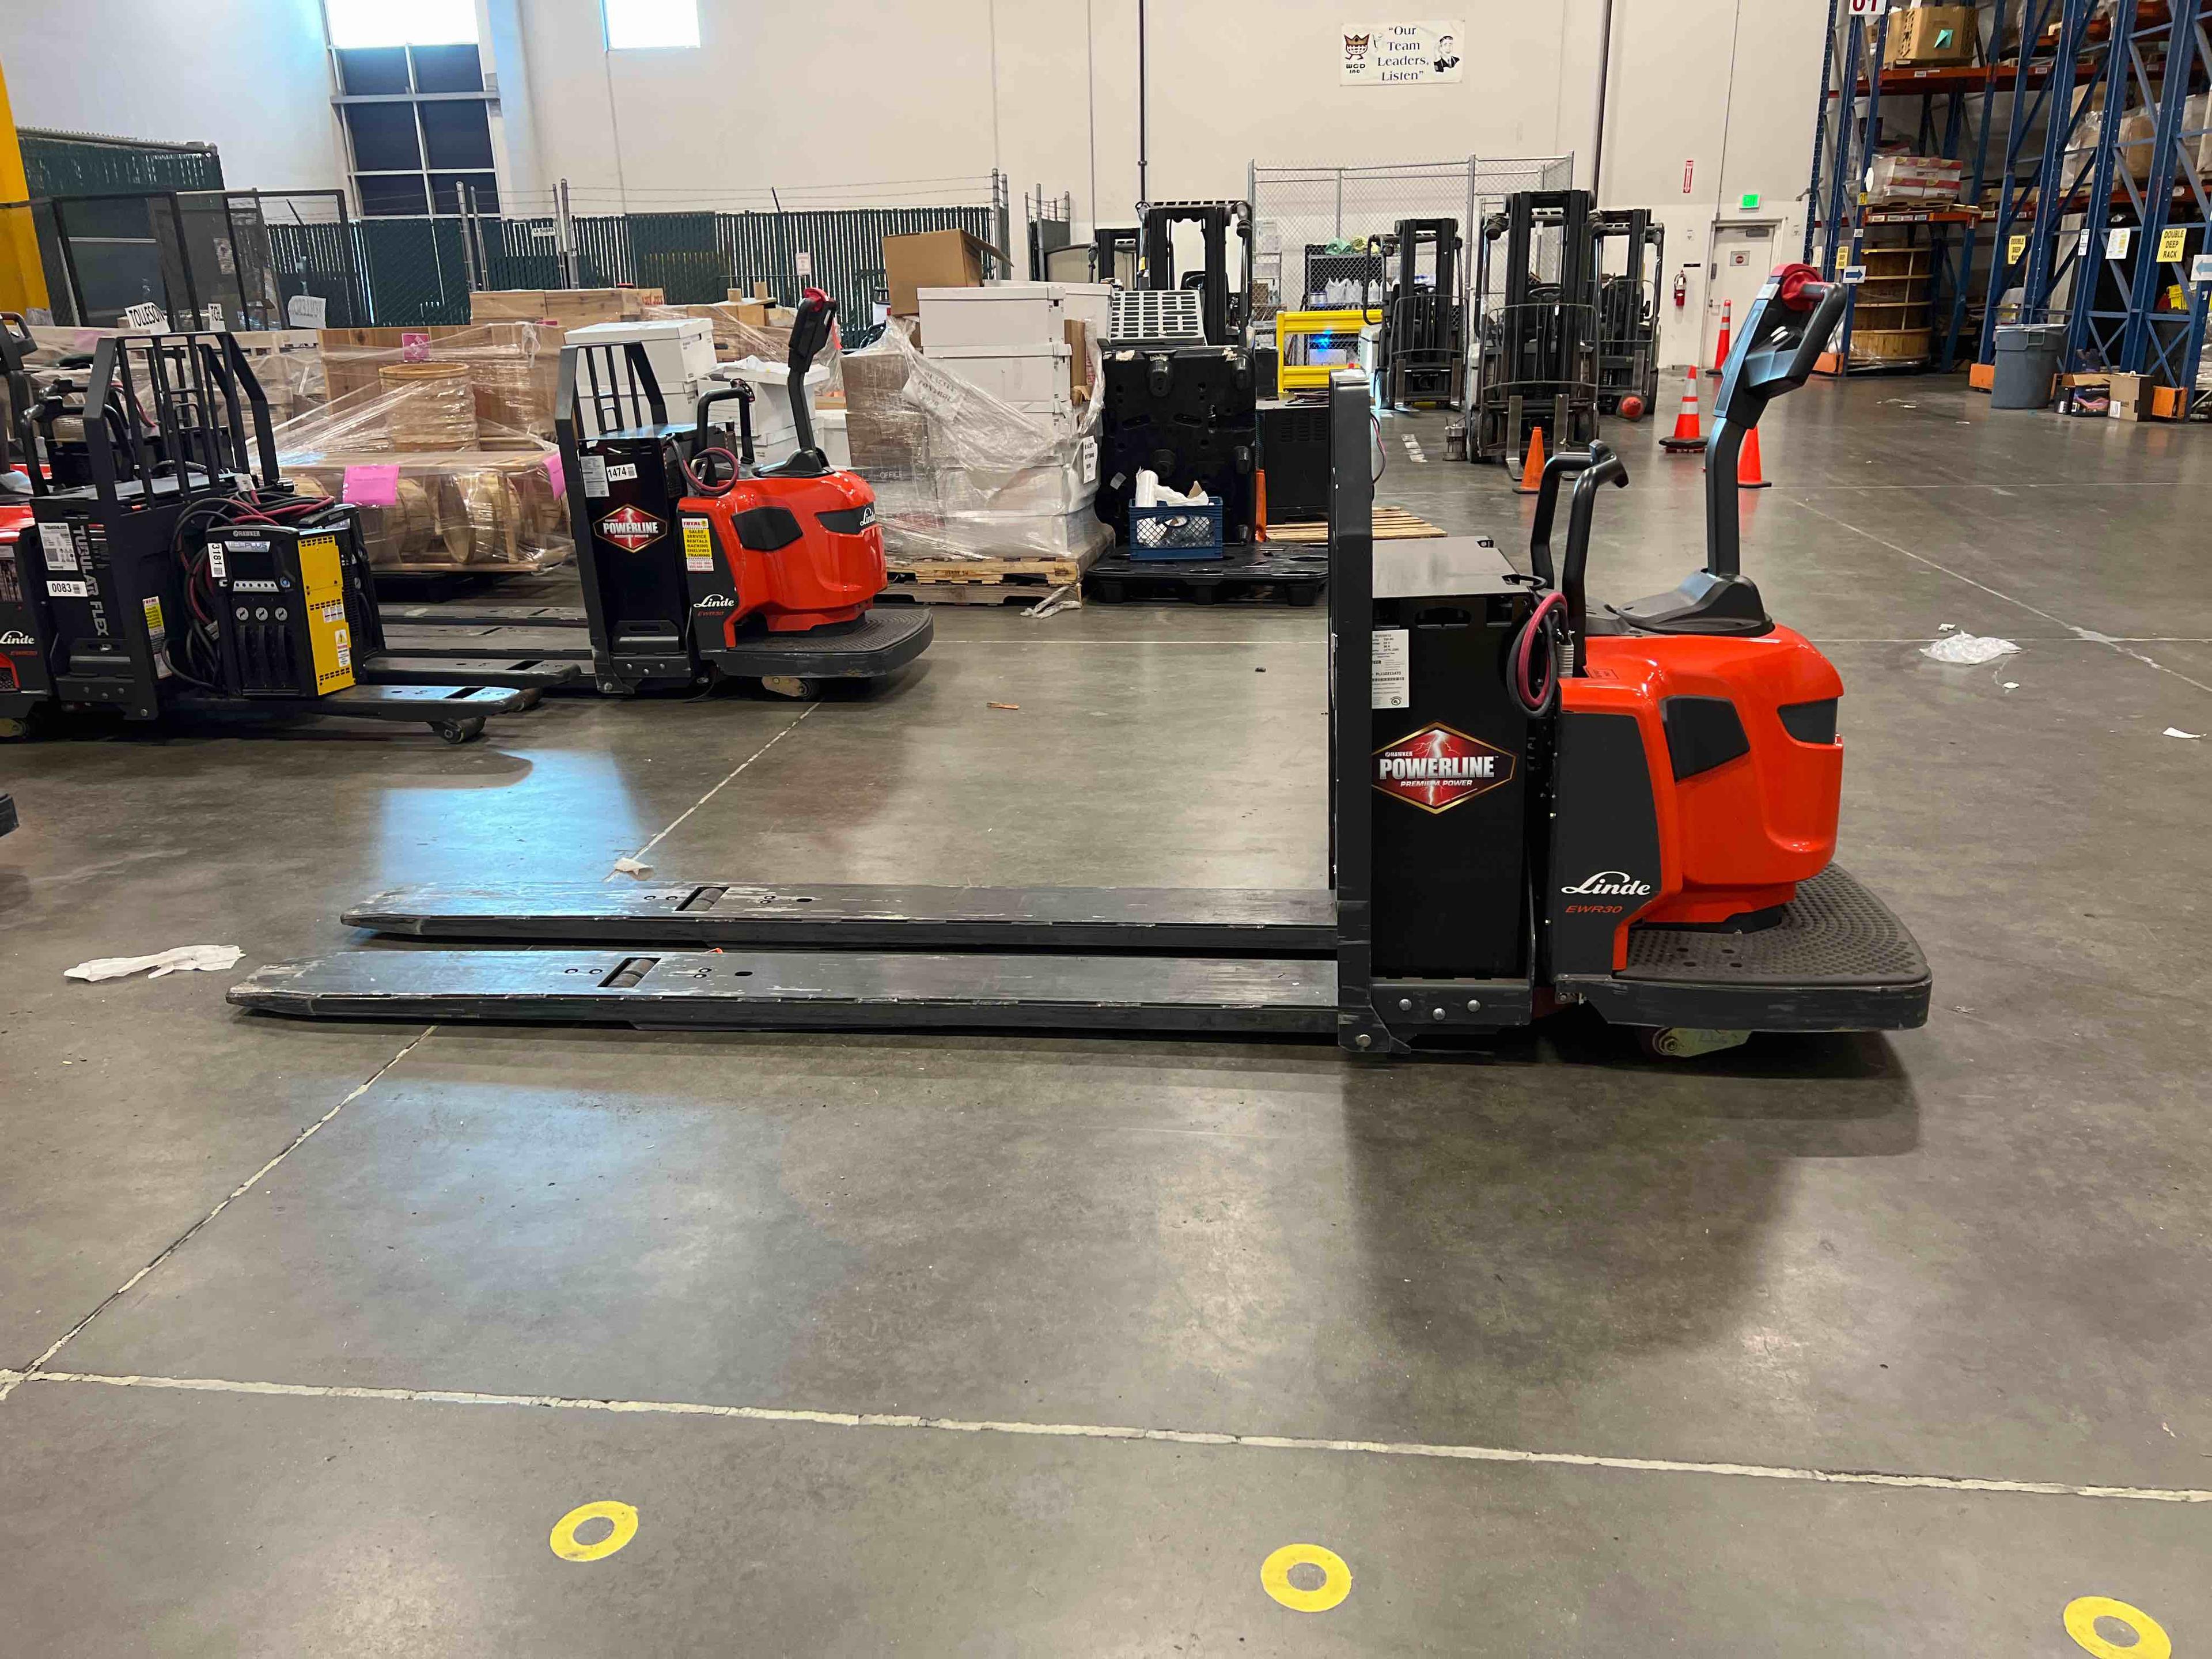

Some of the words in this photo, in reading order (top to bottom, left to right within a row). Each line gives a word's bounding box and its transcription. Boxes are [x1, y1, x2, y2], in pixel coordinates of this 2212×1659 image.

[1387, 41, 1420, 51] Team
[2164, 230, 2185, 239] DOUBLE
[2165, 240, 2179, 249] DEEP
[2162, 251, 2177, 259] RACK
[128, 304, 165, 328] TOLLESON
[608, 467, 627, 478] 1474
[860, 507, 876, 527] Lind
[603, 522, 659, 535] POWERLINE
[73, 525, 99, 597] TUBULAR
[211, 544, 222, 565] 3181
[51, 583, 72, 593] 0083
[693, 594, 734, 608] Linde
[89, 601, 109, 637] FLEX
[1380, 756, 1495, 779] POWERLINE
[1560, 871, 1651, 896] Linde
[1565, 905, 1623, 913] EWR30
